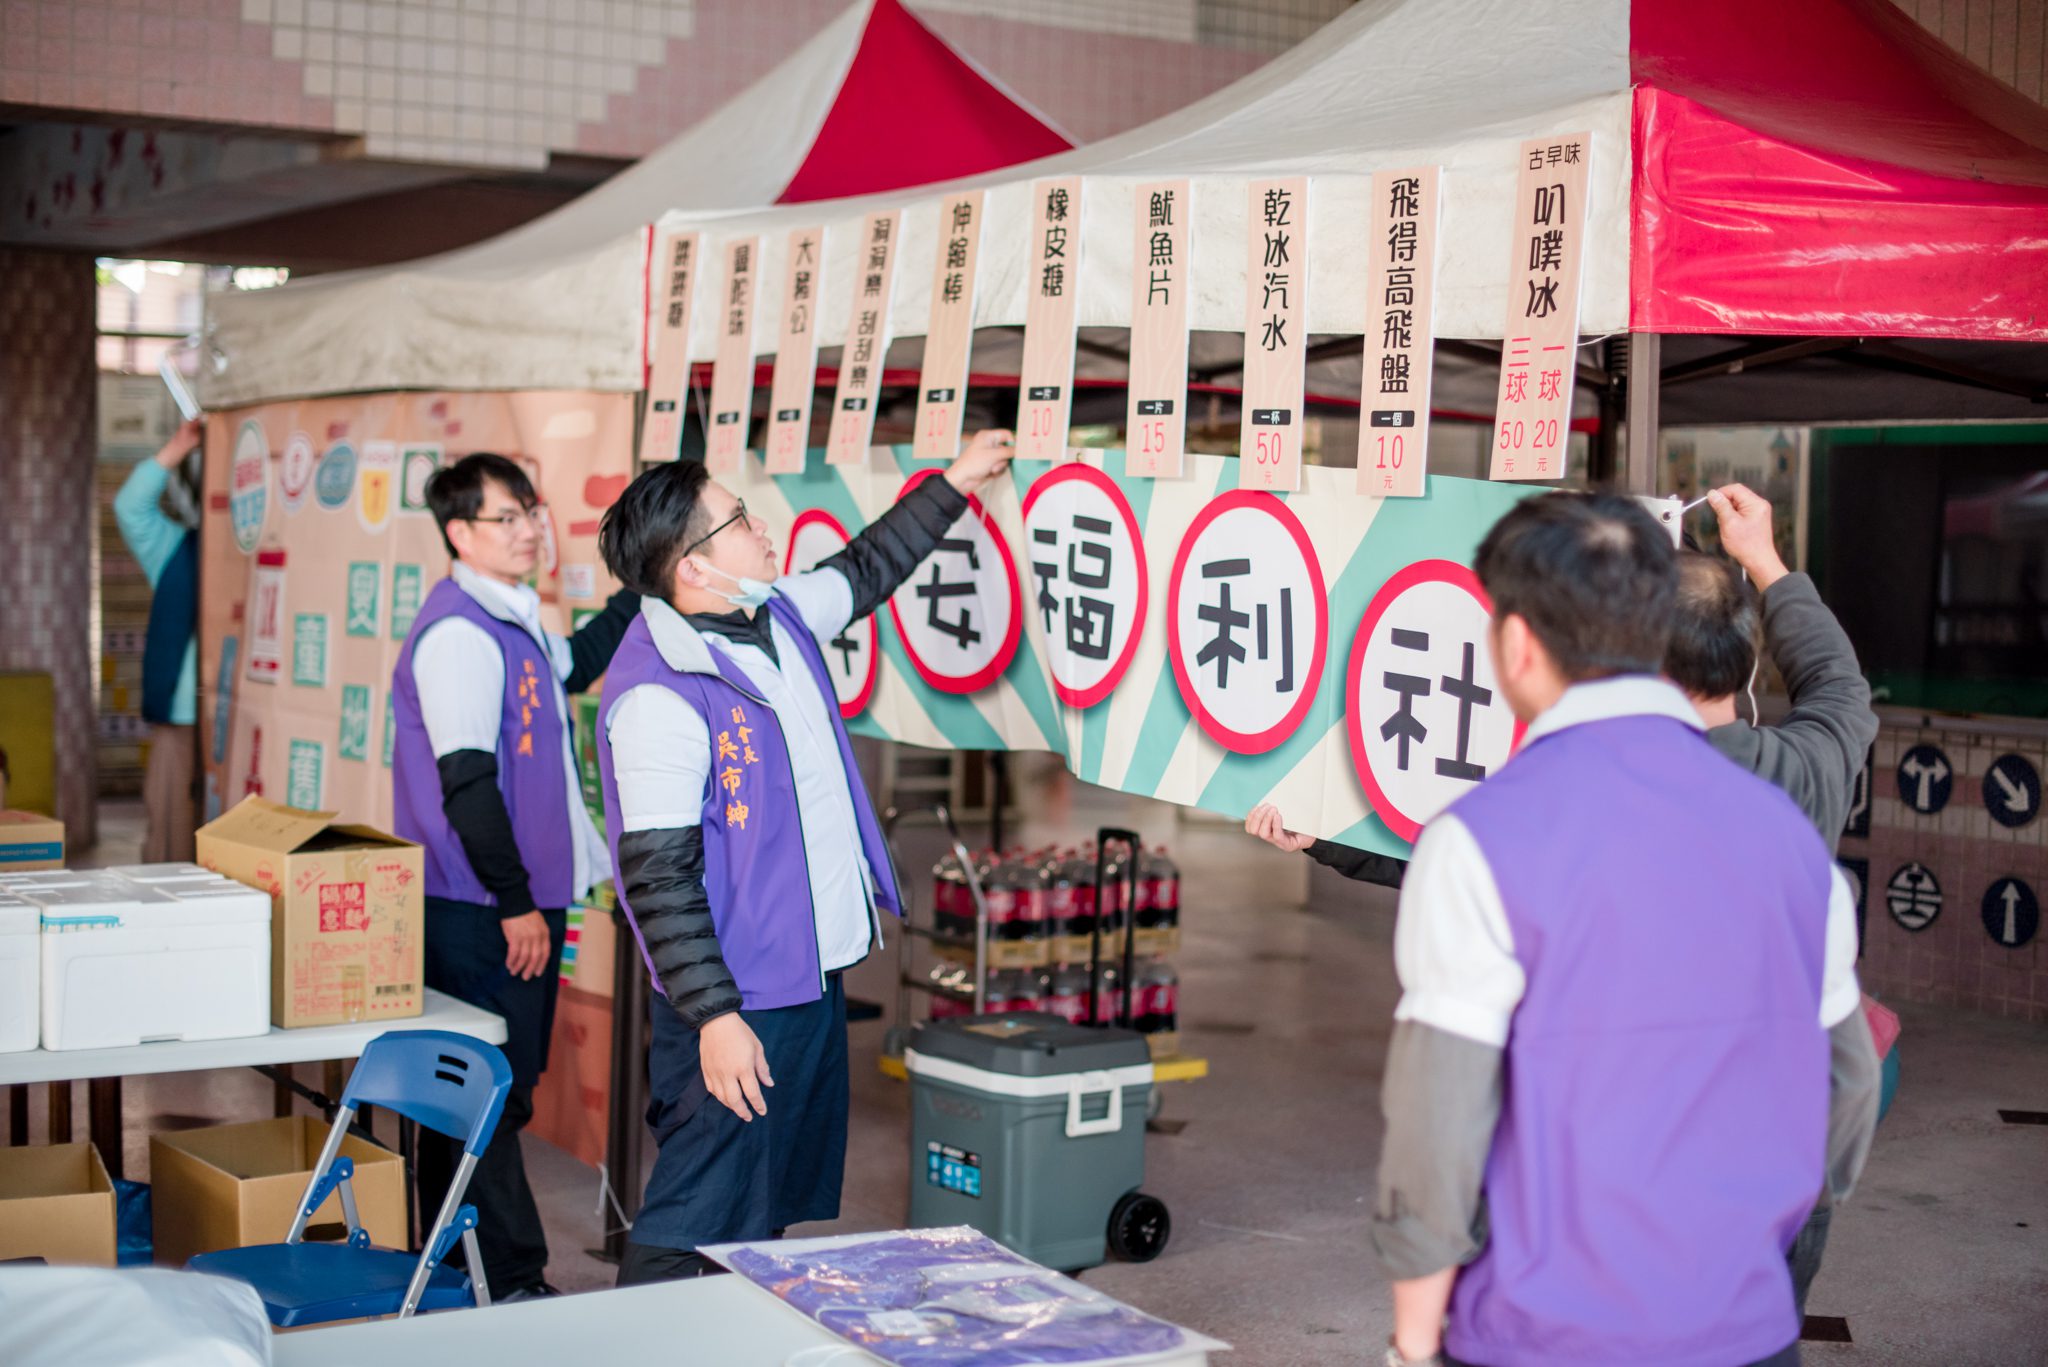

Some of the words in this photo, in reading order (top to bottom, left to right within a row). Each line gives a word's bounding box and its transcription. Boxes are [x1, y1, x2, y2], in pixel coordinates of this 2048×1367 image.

[1528, 141, 1581, 170] 古早味
[1041, 188, 1069, 298] 橡皮糖
[1147, 189, 1175, 306] 魷魚片
[1525, 183, 1566, 318] 叭噗冰
[1261, 188, 1290, 351] 乾冰汽水
[1379, 178, 1419, 394] 飛得高飛盤
[1504, 337, 1532, 404] 三球
[1537, 345, 1565, 402] 一球
[927, 408, 947, 437] 10
[1031, 407, 1053, 437] 10
[1260, 410, 1281, 425] 一杯
[1380, 411, 1403, 427] 一個
[1532, 418, 1558, 449] 20
[1142, 421, 1165, 453] 15
[1256, 432, 1282, 465] 50
[1500, 420, 1524, 450] 50
[1376, 434, 1404, 469] 10
[1503, 457, 1515, 473] 元
[1536, 457, 1548, 472] 元
[1383, 475, 1394, 489] 元
[800, 513, 1494, 782] 安福利社
[731, 705, 759, 765] 副會長
